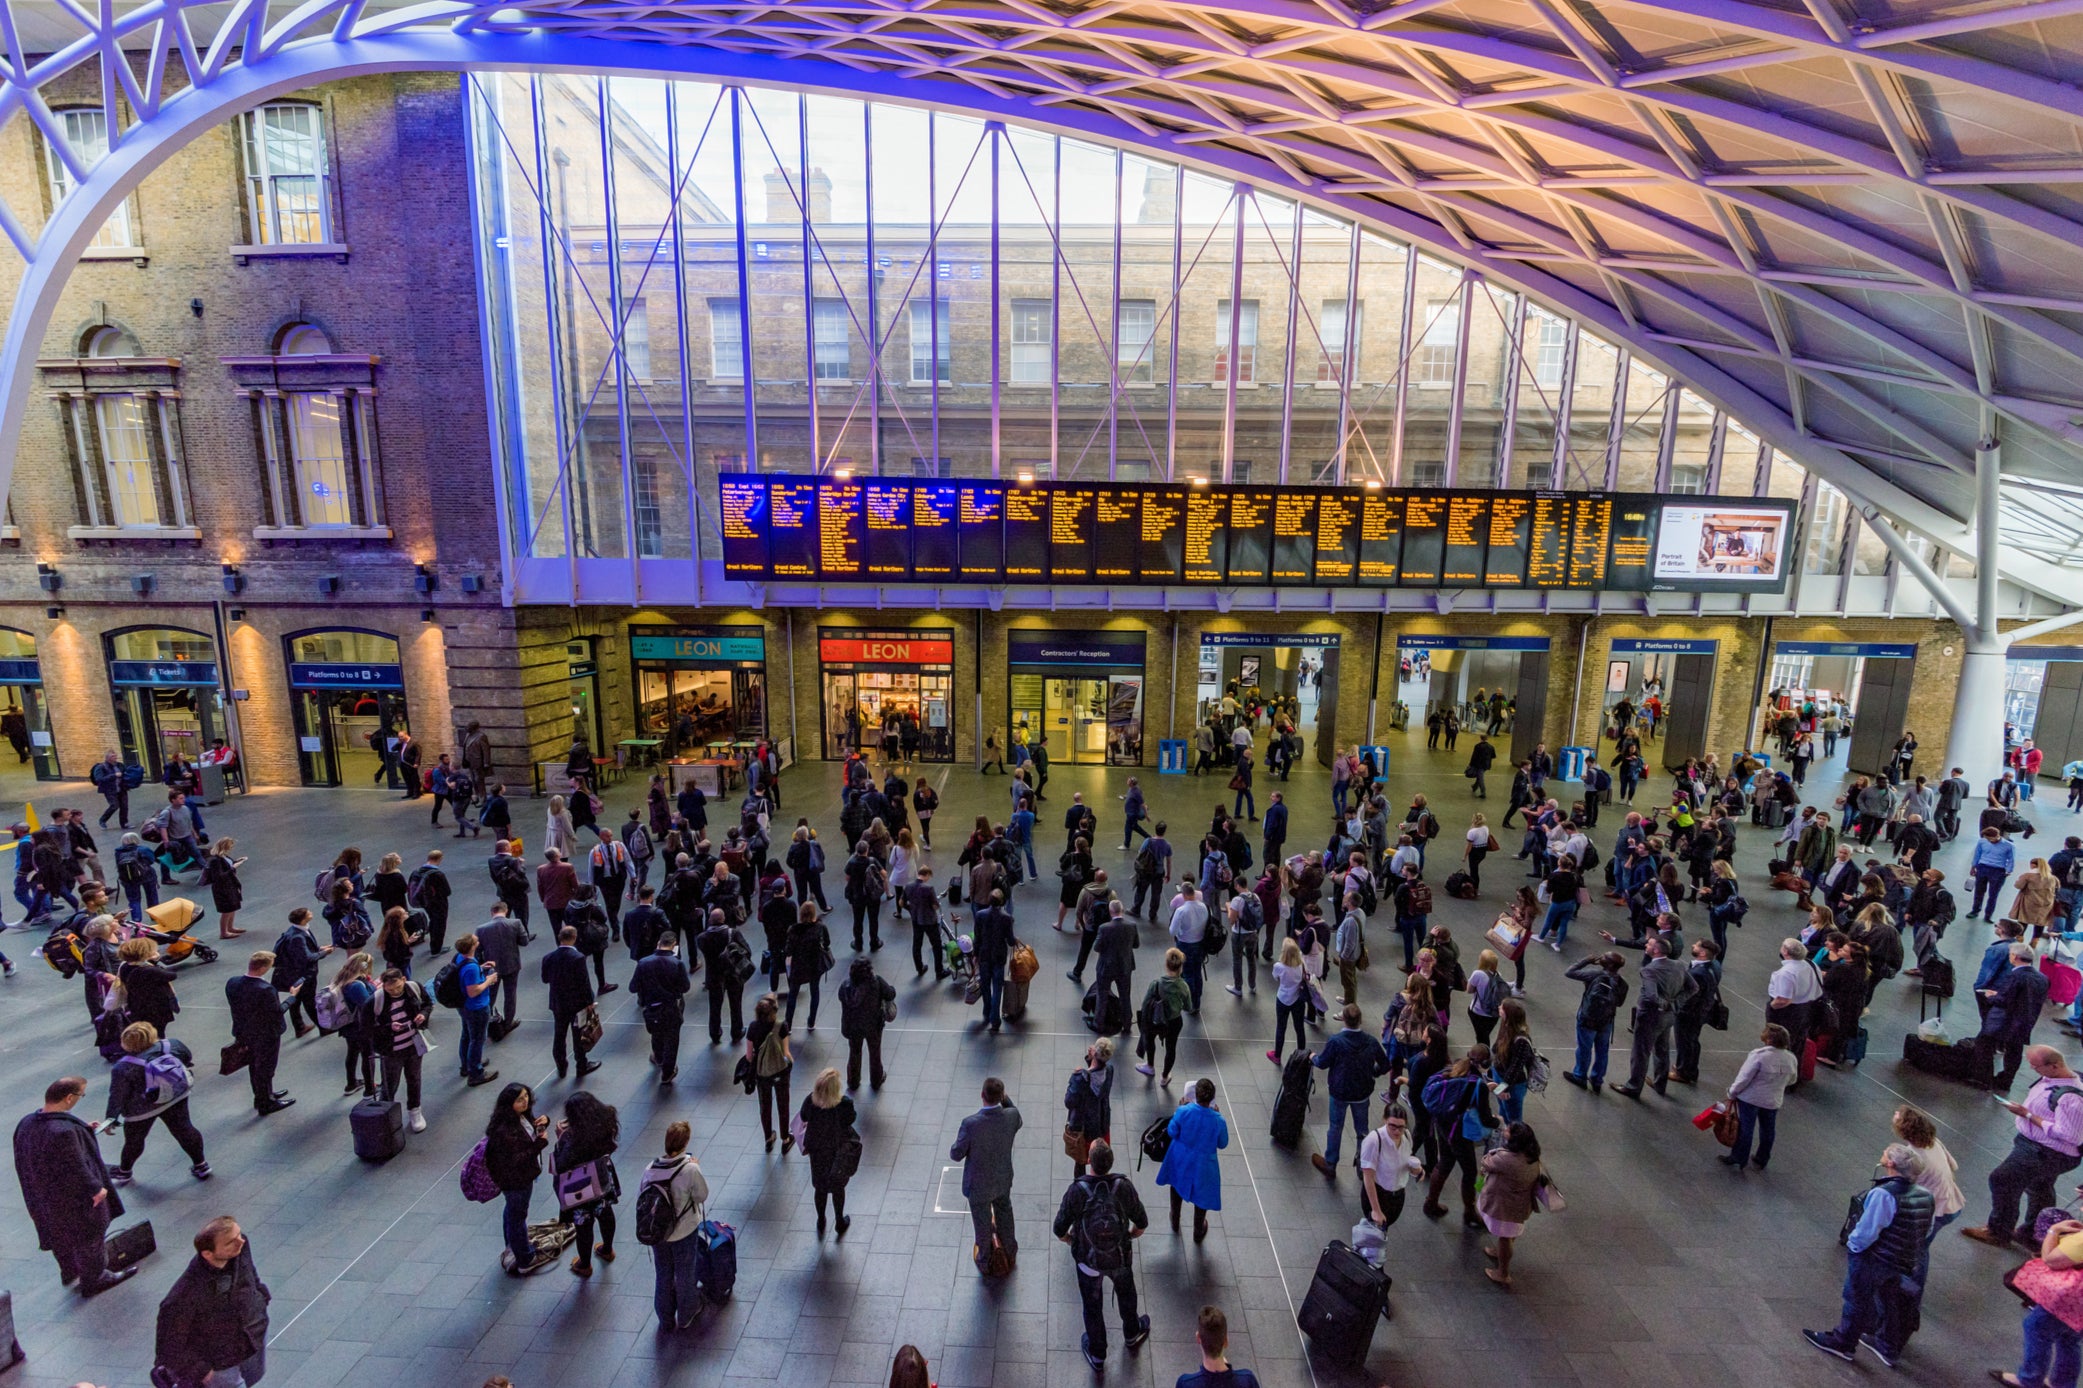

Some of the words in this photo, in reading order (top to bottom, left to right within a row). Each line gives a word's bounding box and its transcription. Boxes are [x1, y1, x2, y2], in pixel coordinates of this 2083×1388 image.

[675, 640, 721, 656] LEON
[863, 644, 910, 659] LEON
[308, 671, 338, 680] Platforms
